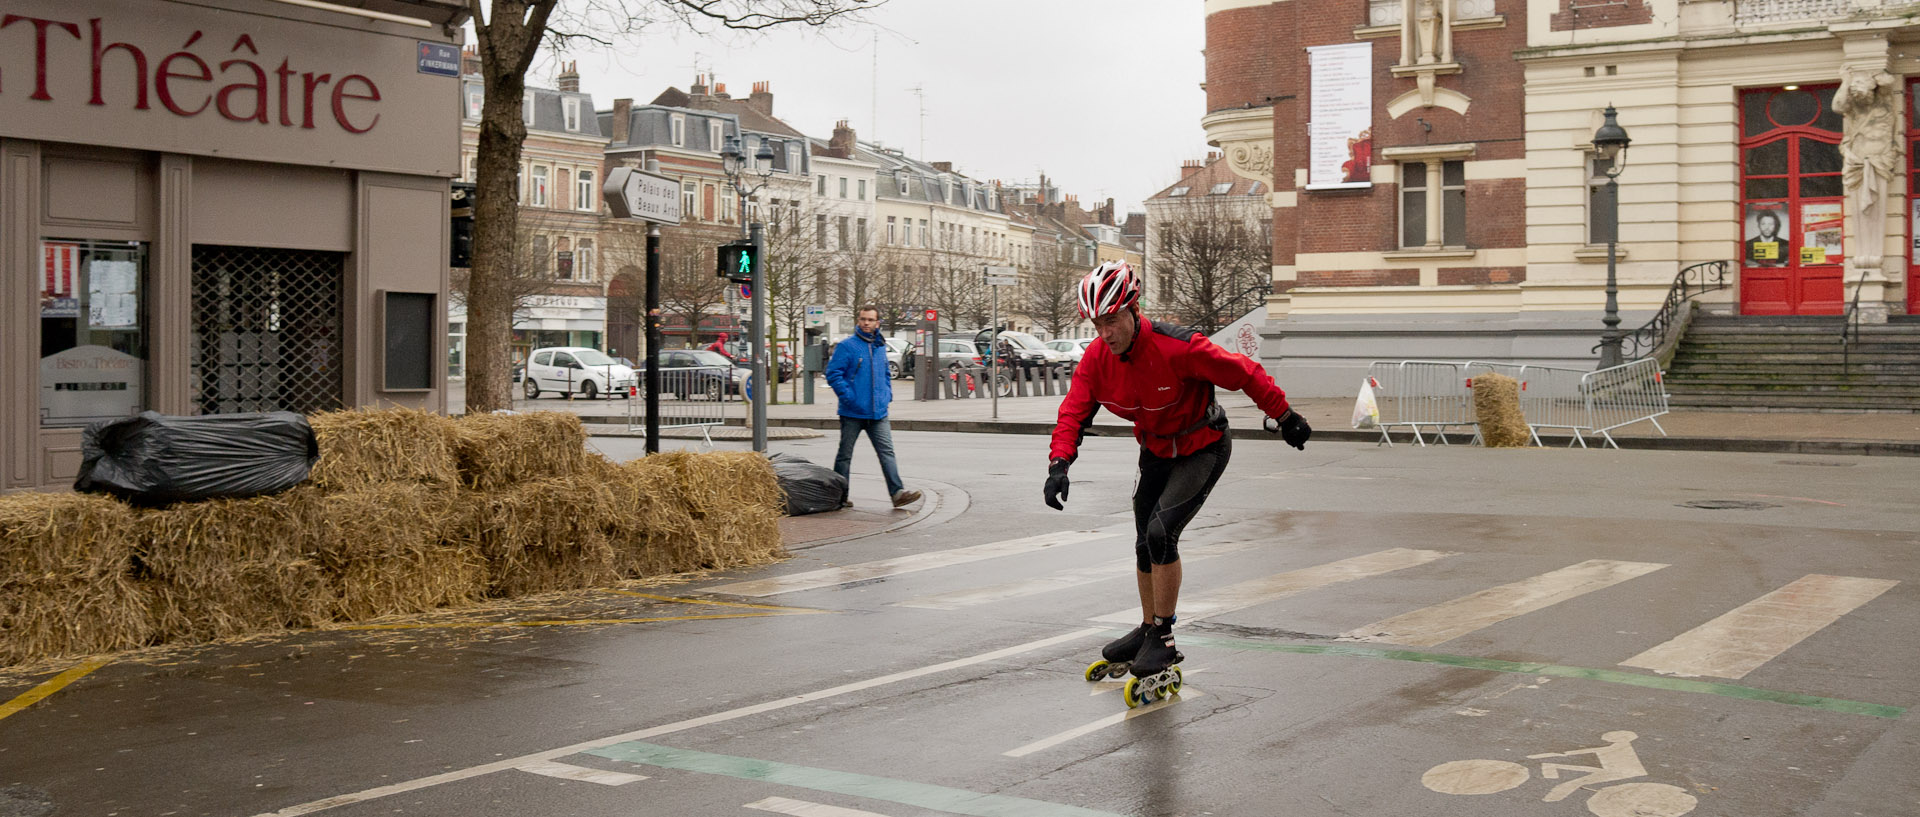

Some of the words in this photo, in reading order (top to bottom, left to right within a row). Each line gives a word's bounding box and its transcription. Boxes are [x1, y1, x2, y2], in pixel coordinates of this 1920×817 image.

[439, 49, 450, 58] Rue
[2, 14, 381, 133] Théâtre
[638, 179, 660, 196] Palais
[663, 186, 674, 199] des
[638, 197, 659, 213] Beaux
[663, 203, 678, 217] Arts
